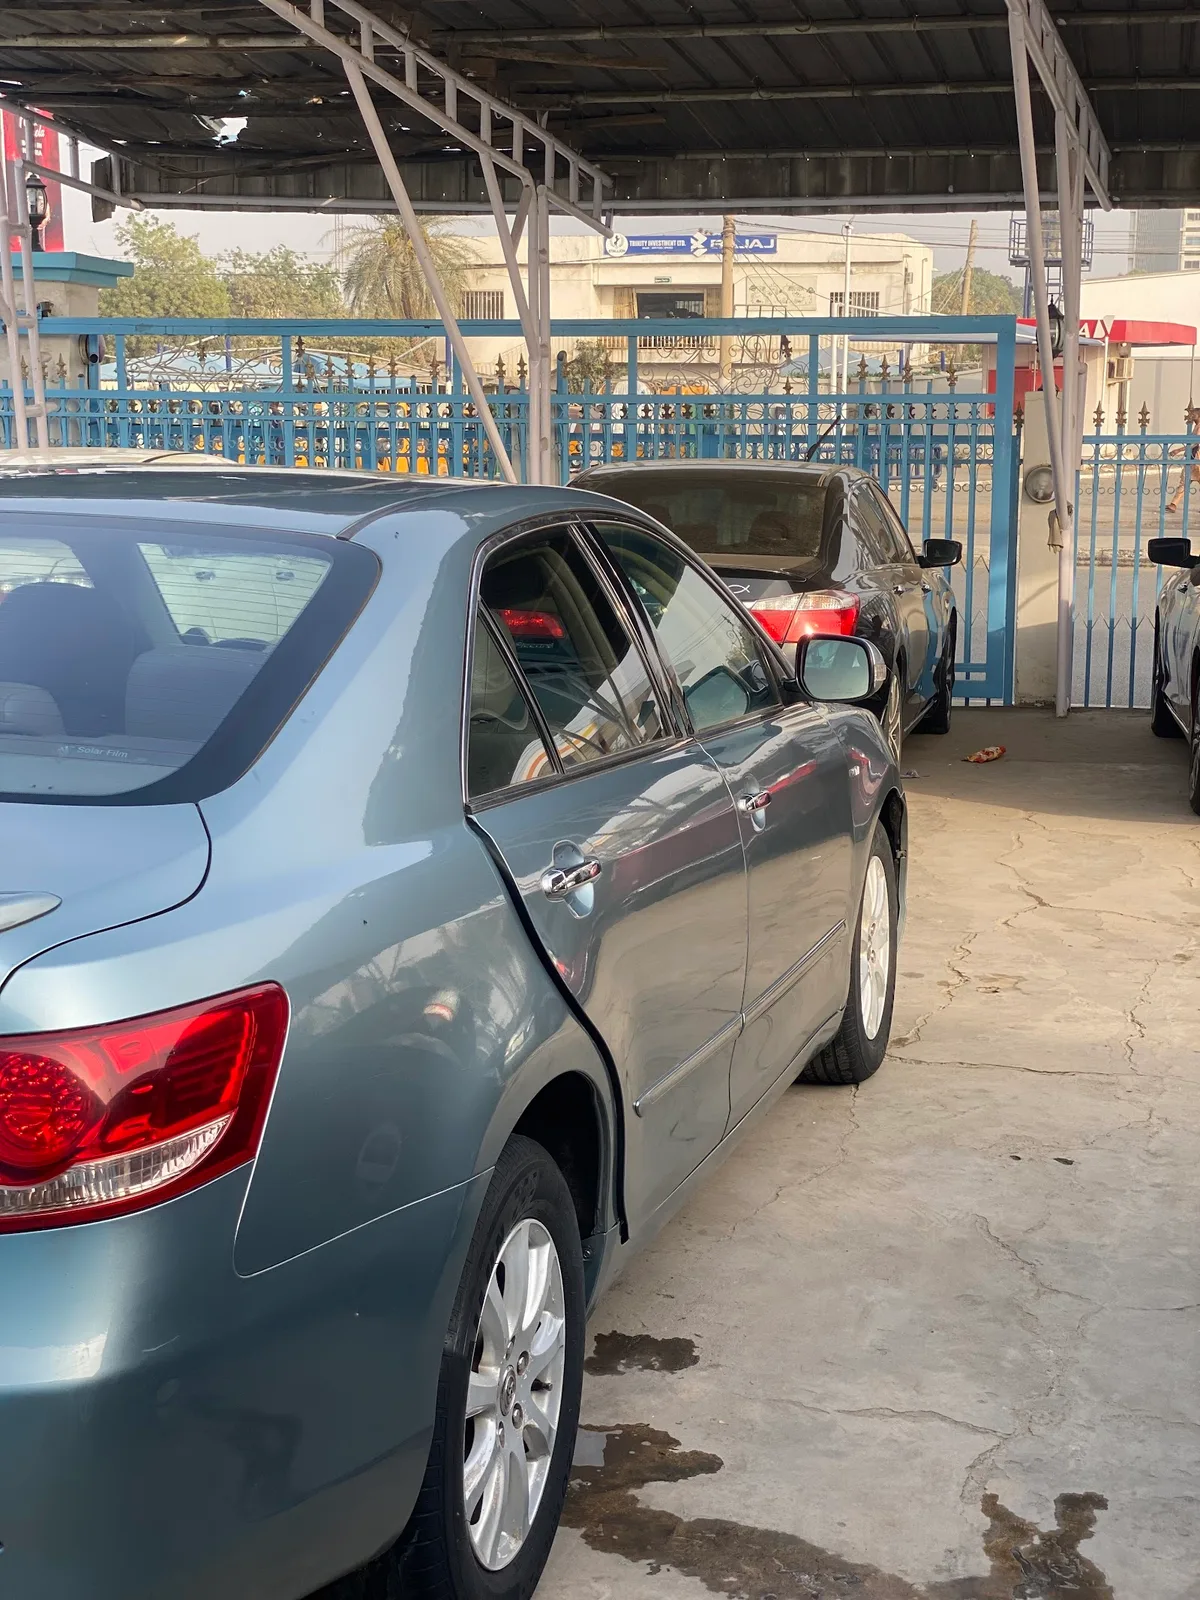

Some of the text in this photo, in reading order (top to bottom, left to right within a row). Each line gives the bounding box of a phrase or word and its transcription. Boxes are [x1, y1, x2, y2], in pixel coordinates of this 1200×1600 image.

[710, 239, 775, 249] BJAJ
[76, 746, 103, 756] Solar
[106, 749, 128, 758] Film
